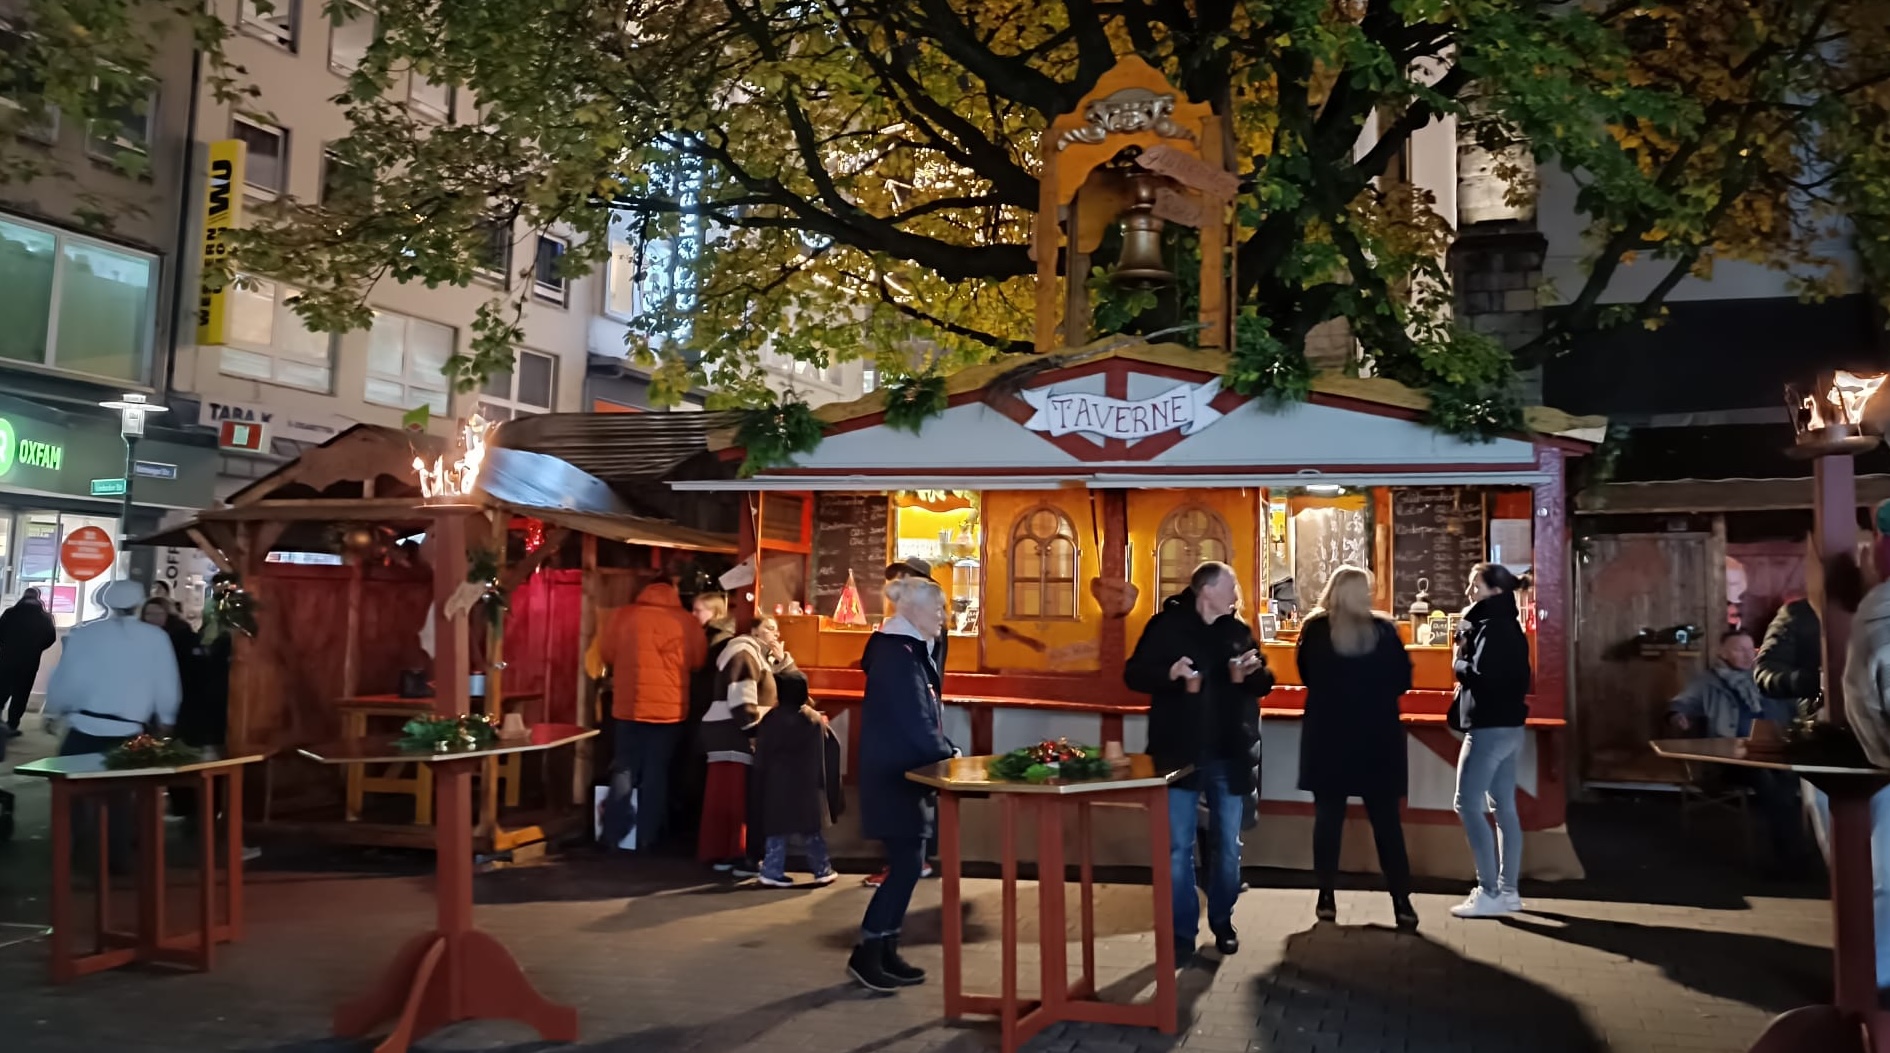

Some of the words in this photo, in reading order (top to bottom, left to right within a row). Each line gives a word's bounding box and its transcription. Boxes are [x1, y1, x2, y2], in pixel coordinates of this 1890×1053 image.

[208, 160, 232, 216] WU
[1052, 396, 1188, 433] TAVERNE
[19, 439, 61, 470] OXFAM
